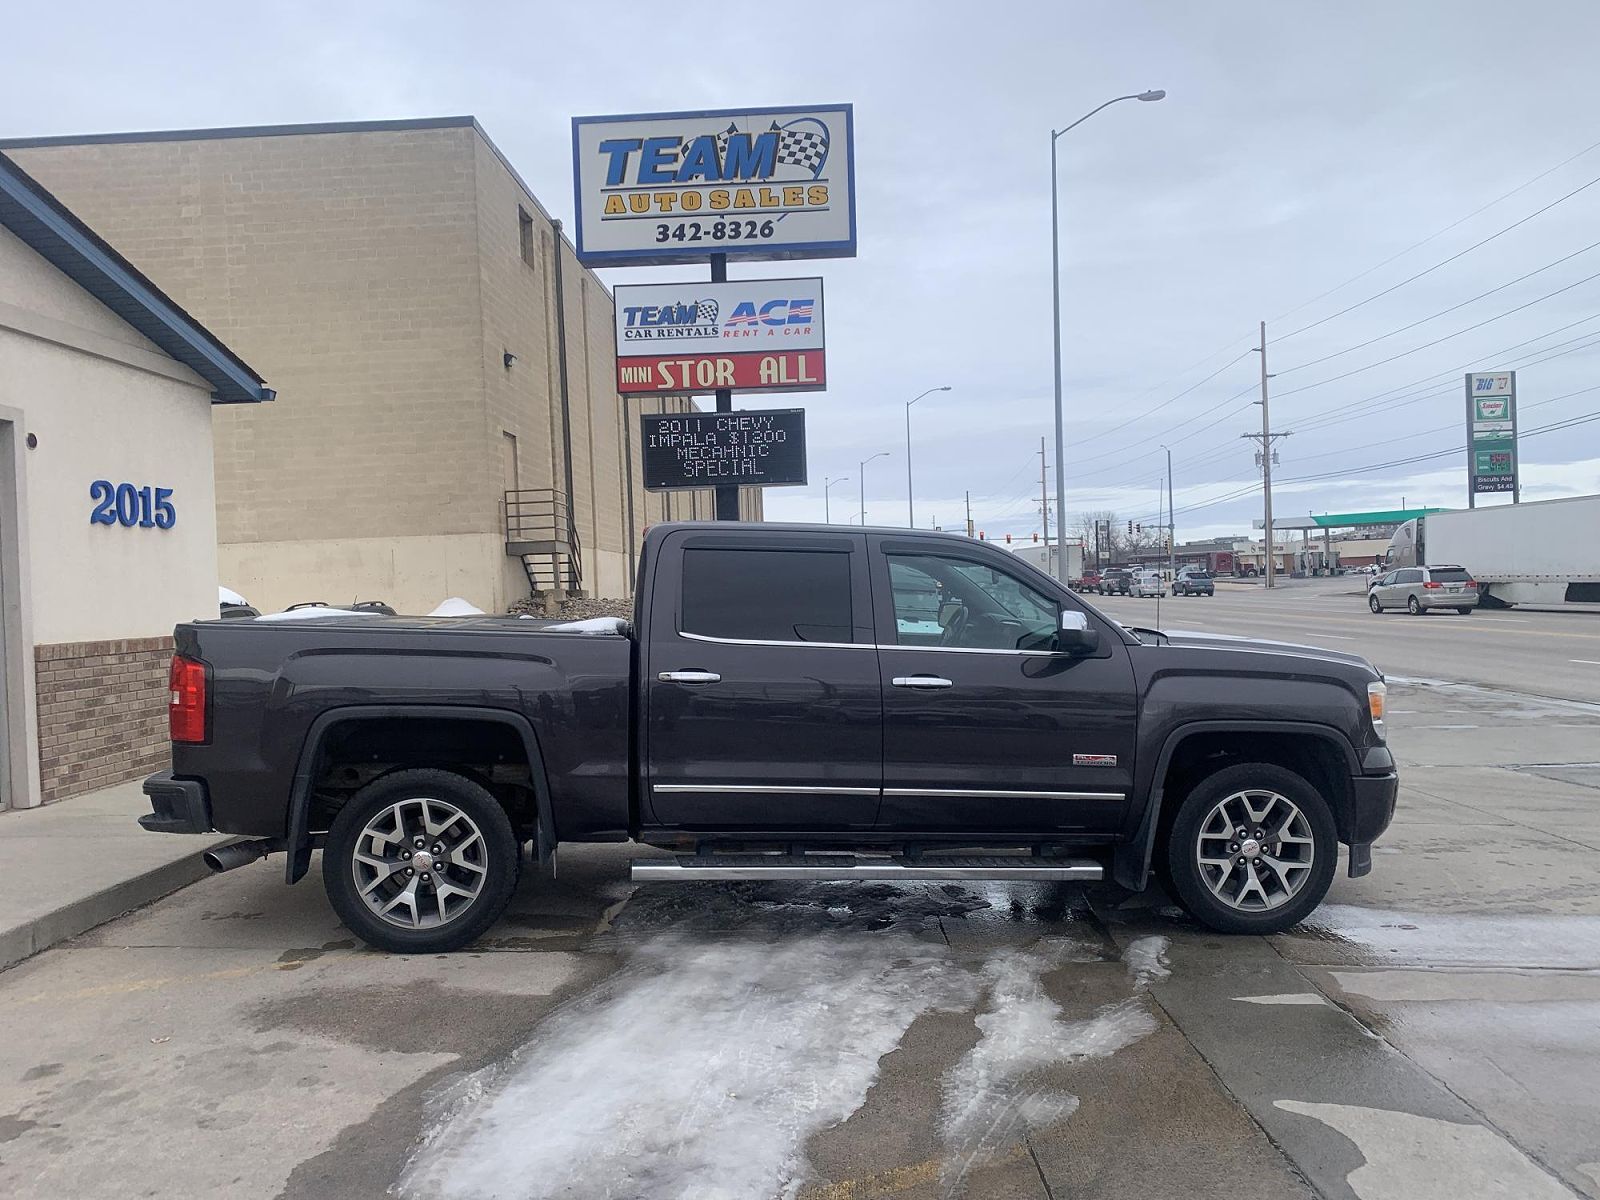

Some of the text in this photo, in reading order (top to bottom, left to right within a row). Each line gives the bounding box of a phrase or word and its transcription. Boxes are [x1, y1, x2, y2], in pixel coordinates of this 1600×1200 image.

[599, 131, 781, 186] TEAM
[604, 185, 830, 215] AUTO SALES
[655, 220, 775, 243] 342-8326
[623, 302, 699, 327] TEAM
[723, 299, 815, 327] ACE
[625, 326, 719, 339] CAR RENTALS
[723, 327, 812, 338] RENT A CAR
[621, 354, 817, 389] MINI STOR ALL
[1475, 377, 1494, 391] BIG
[658, 416, 774, 434] 2011 CHEVY
[649, 429, 787, 448] IMPALA $1200
[677, 444, 770, 460] MECAHNIC
[683, 458, 765, 477] SPECIAL
[90, 480, 176, 529] 2015
